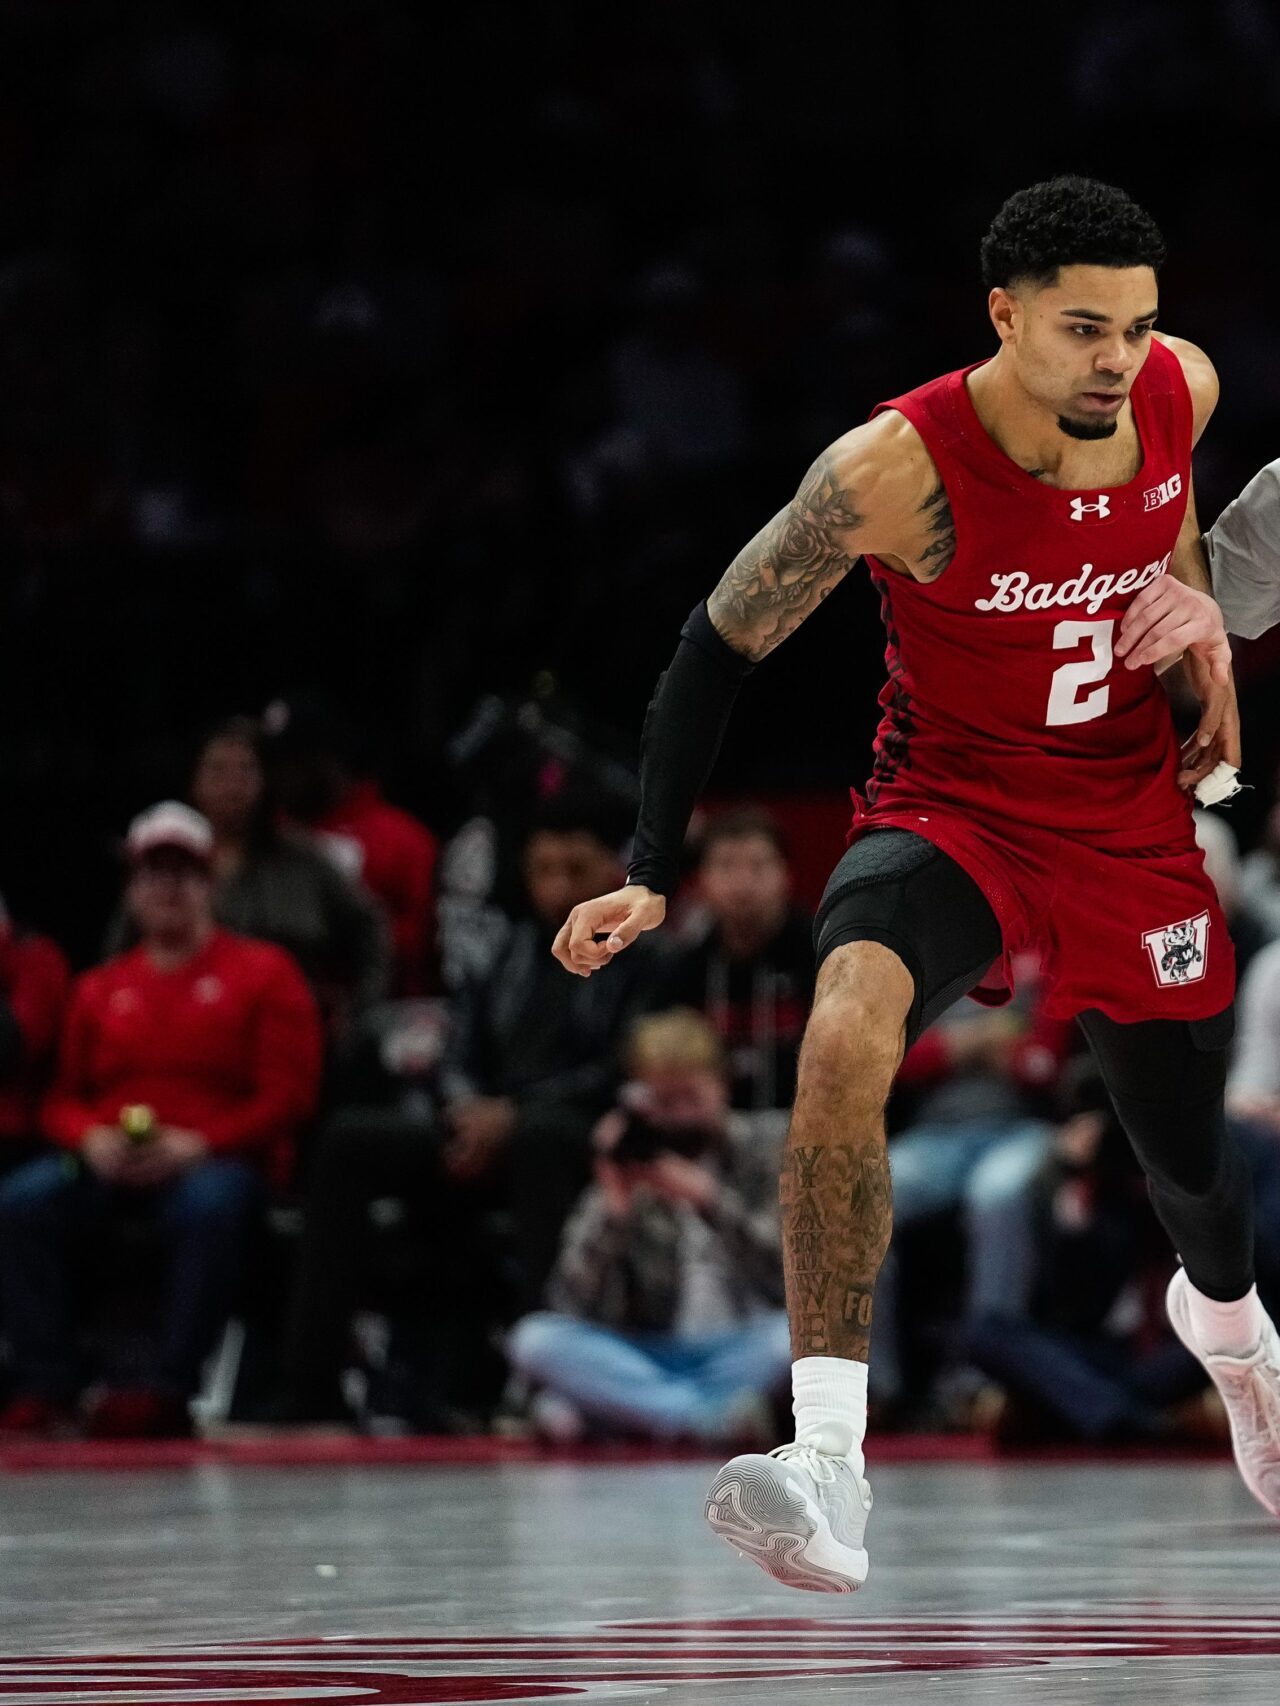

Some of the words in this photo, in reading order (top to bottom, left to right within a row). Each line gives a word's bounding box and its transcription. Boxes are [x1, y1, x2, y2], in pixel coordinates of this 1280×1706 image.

[974, 550, 1172, 615] Badgers
[1045, 619, 1115, 726] 2
[1141, 908, 1212, 988] W
